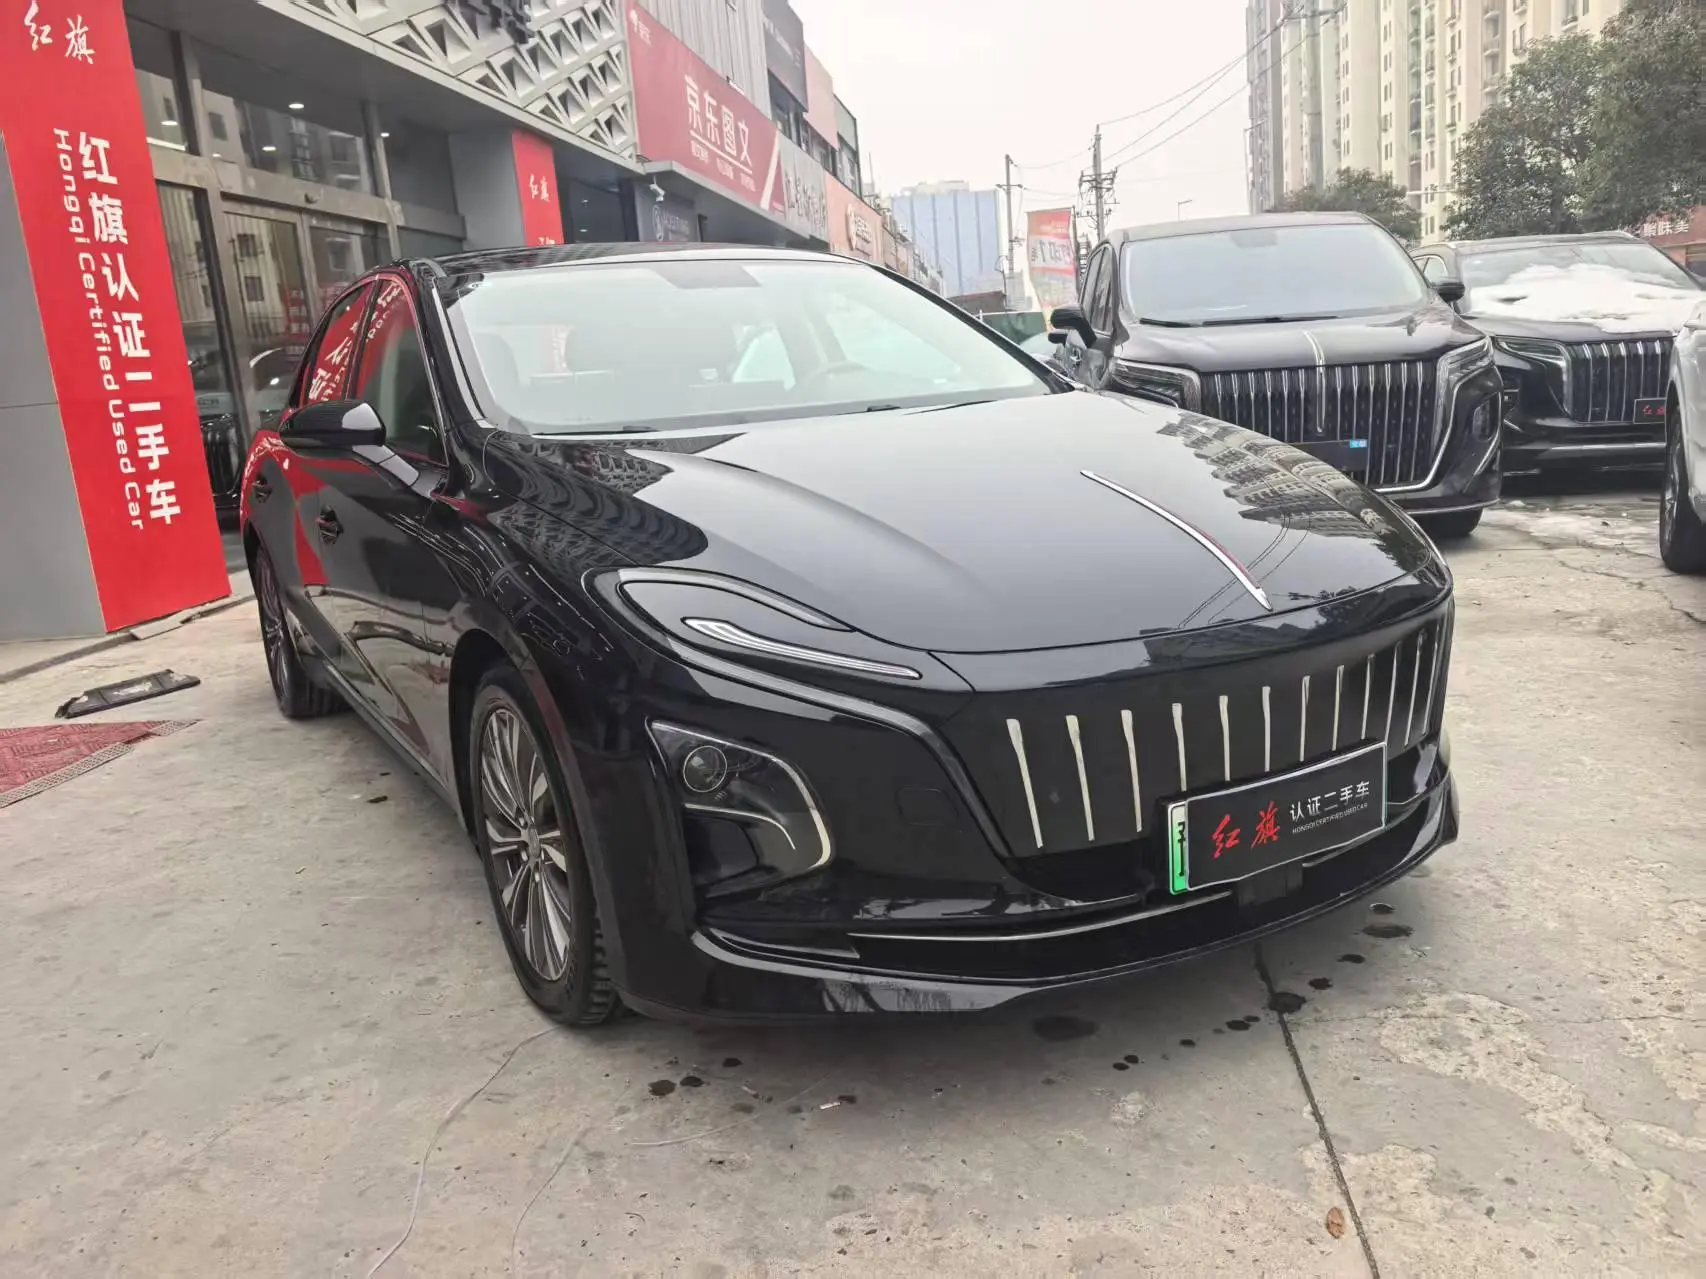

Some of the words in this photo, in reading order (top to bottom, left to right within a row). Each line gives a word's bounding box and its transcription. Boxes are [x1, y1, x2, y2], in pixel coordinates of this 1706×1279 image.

[24, 0, 95, 64] 红旗
[684, 74, 752, 167] 京东图文
[53, 128, 90, 243] Hongqi
[79, 252, 119, 390] Certified
[109, 399, 136, 474] Used
[125, 481, 143, 530] Car
[79, 131, 181, 524] 红旗认证二手车
[1212, 801, 1280, 859] 红旗
[1289, 781, 1370, 822] 认证二手车
